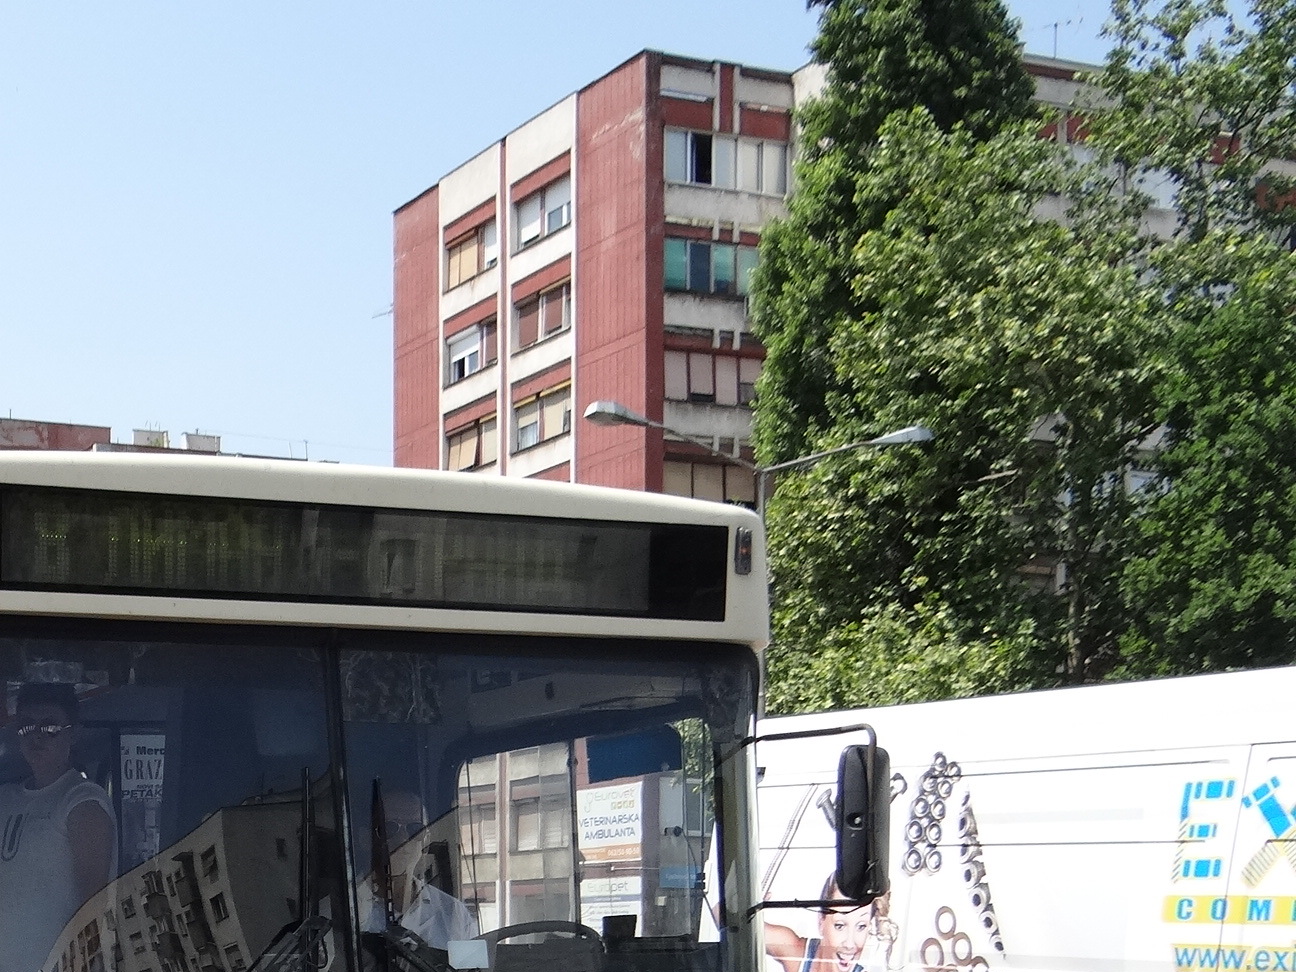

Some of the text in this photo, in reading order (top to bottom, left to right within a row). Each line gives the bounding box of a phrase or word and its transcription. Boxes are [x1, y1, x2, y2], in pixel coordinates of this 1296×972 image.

[579, 813, 640, 828] VETERINARSKA
[585, 827, 636, 841] AMBULANTA
[1176, 897, 1296, 921] COM
